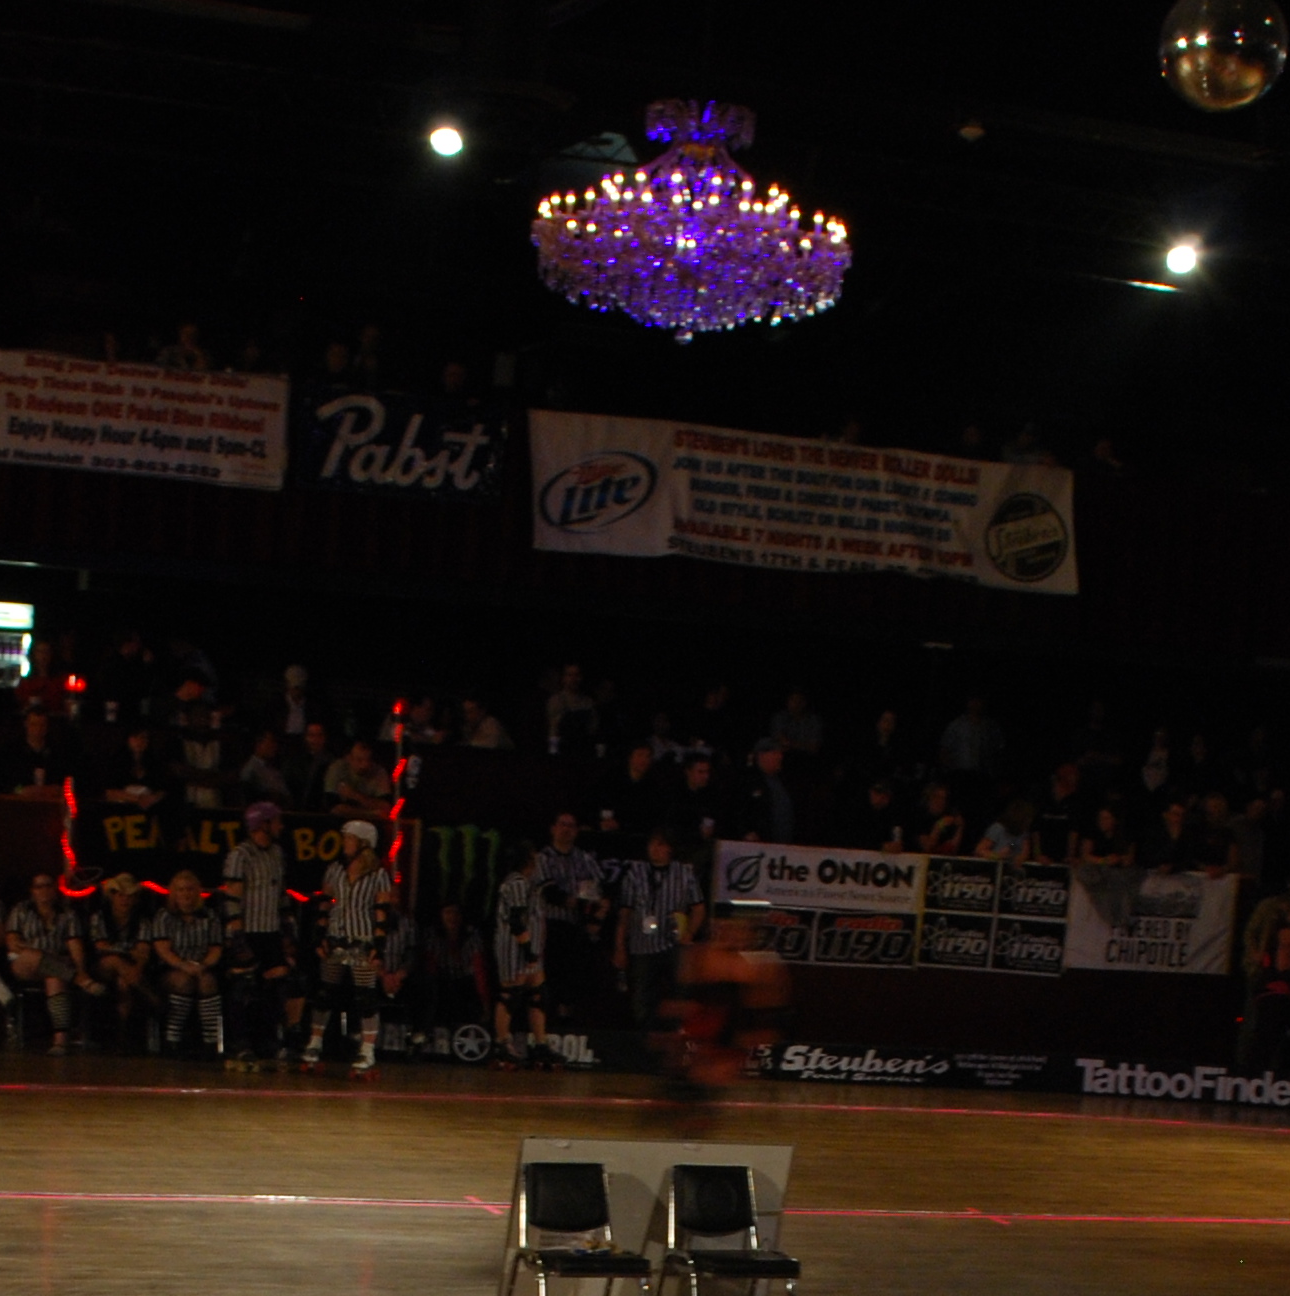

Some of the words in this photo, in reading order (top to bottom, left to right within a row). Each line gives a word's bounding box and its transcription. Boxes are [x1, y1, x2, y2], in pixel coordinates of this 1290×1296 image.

[91, 401, 123, 419] ONE
[9, 416, 47, 442] Enjoy
[51, 420, 96, 446] Happy
[100, 424, 136, 445] Hour
[186, 436, 212, 451] and
[315, 393, 491, 491] Pabst
[560, 476, 641, 525] Lite
[668, 535, 754, 563] STEUBEN'S
[293, 827, 344, 862] BO
[767, 856, 808, 881] the
[818, 859, 915, 888] ONION
[941, 882, 994, 900] 1190
[1016, 887, 1068, 905] 1190
[836, 916, 904, 931] radio
[816, 929, 914, 963] 1190
[936, 937, 989, 955] 1190
[1010, 942, 1063, 961] 1190
[1106, 939, 1188, 967] CHIPOTLE
[780, 1045, 951, 1076] Steuben's
